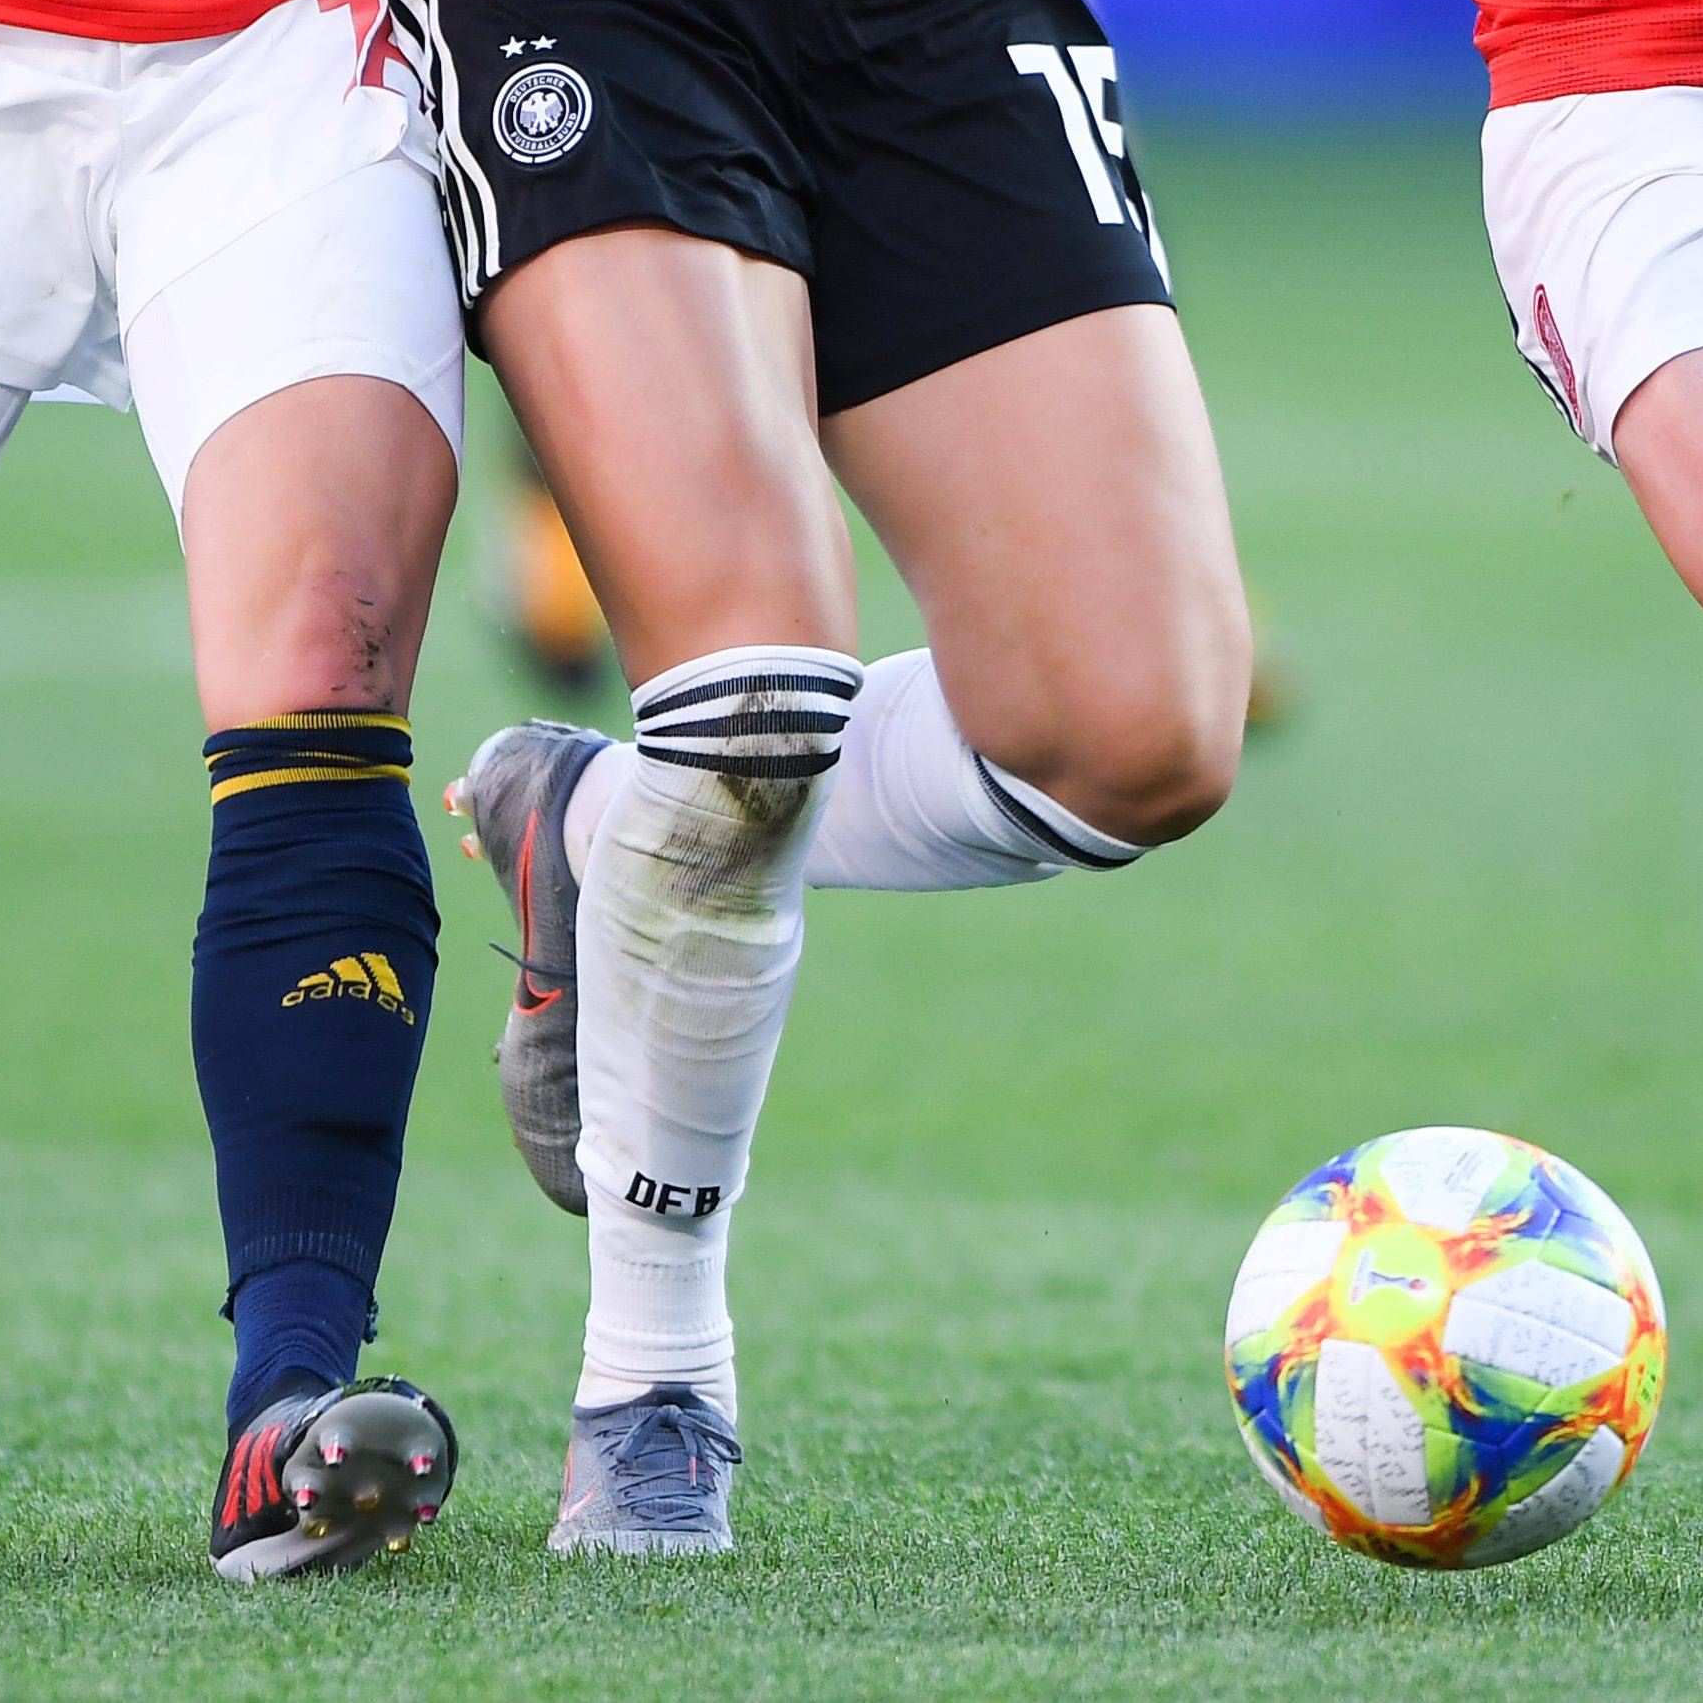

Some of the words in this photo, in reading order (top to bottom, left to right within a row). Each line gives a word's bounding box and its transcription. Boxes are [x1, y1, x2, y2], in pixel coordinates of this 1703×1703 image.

[509, 77, 565, 103] DEUTSCHER
[510, 112, 577, 150] FUSSBALL-BUND
[282, 979, 415, 1026] adidas
[624, 1170, 720, 1217] DFB
